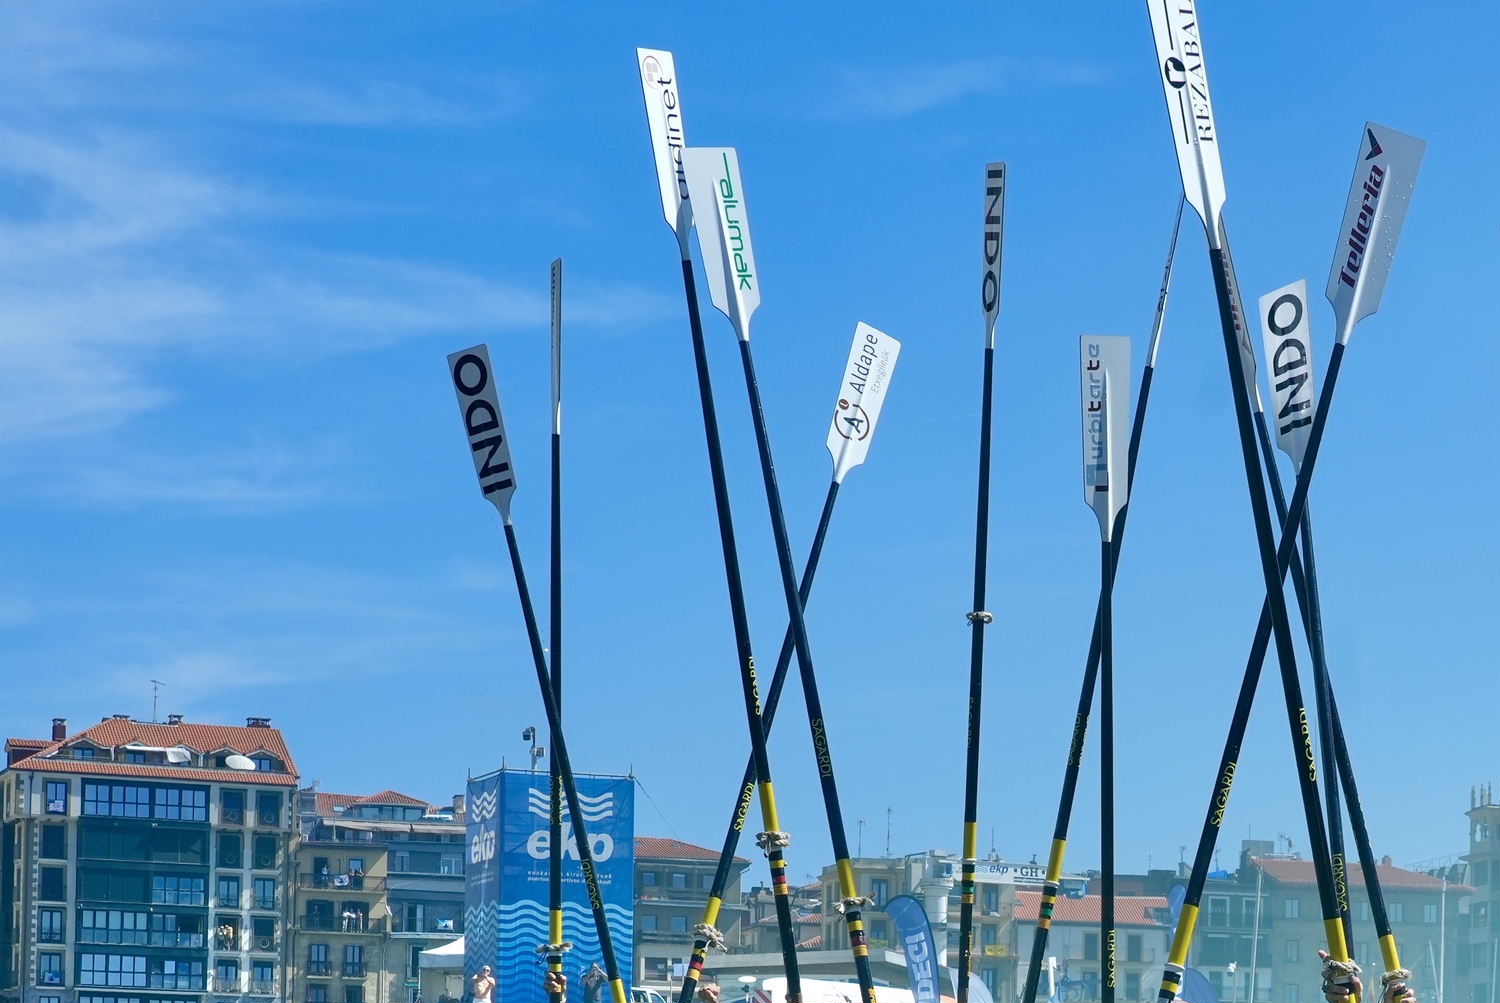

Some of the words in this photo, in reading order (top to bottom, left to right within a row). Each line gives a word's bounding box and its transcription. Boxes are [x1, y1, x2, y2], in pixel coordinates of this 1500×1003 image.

[720, 152, 753, 291] alumak
[982, 169, 1003, 313] INDO
[1337, 164, 1385, 289] Telleria
[849, 333, 878, 395] Aldape
[870, 350, 890, 394] Etxegileak
[1267, 293, 1312, 436] INDO
[453, 354, 513, 495] INDO
[811, 718, 832, 778] SAGARDI
[1298, 707, 1317, 782] SAGARDI
[734, 782, 755, 833] SAGARDI
[1209, 761, 1237, 828] SAGARDI
[526, 821, 614, 871] ekp
[989, 864, 1008, 875] ekp
[1020, 866, 1038, 877] GH
[581, 858, 600, 909] SAGARDI
[1332, 853, 1348, 912] SAGARDI
[1107, 929, 1115, 988] SAGARDI
